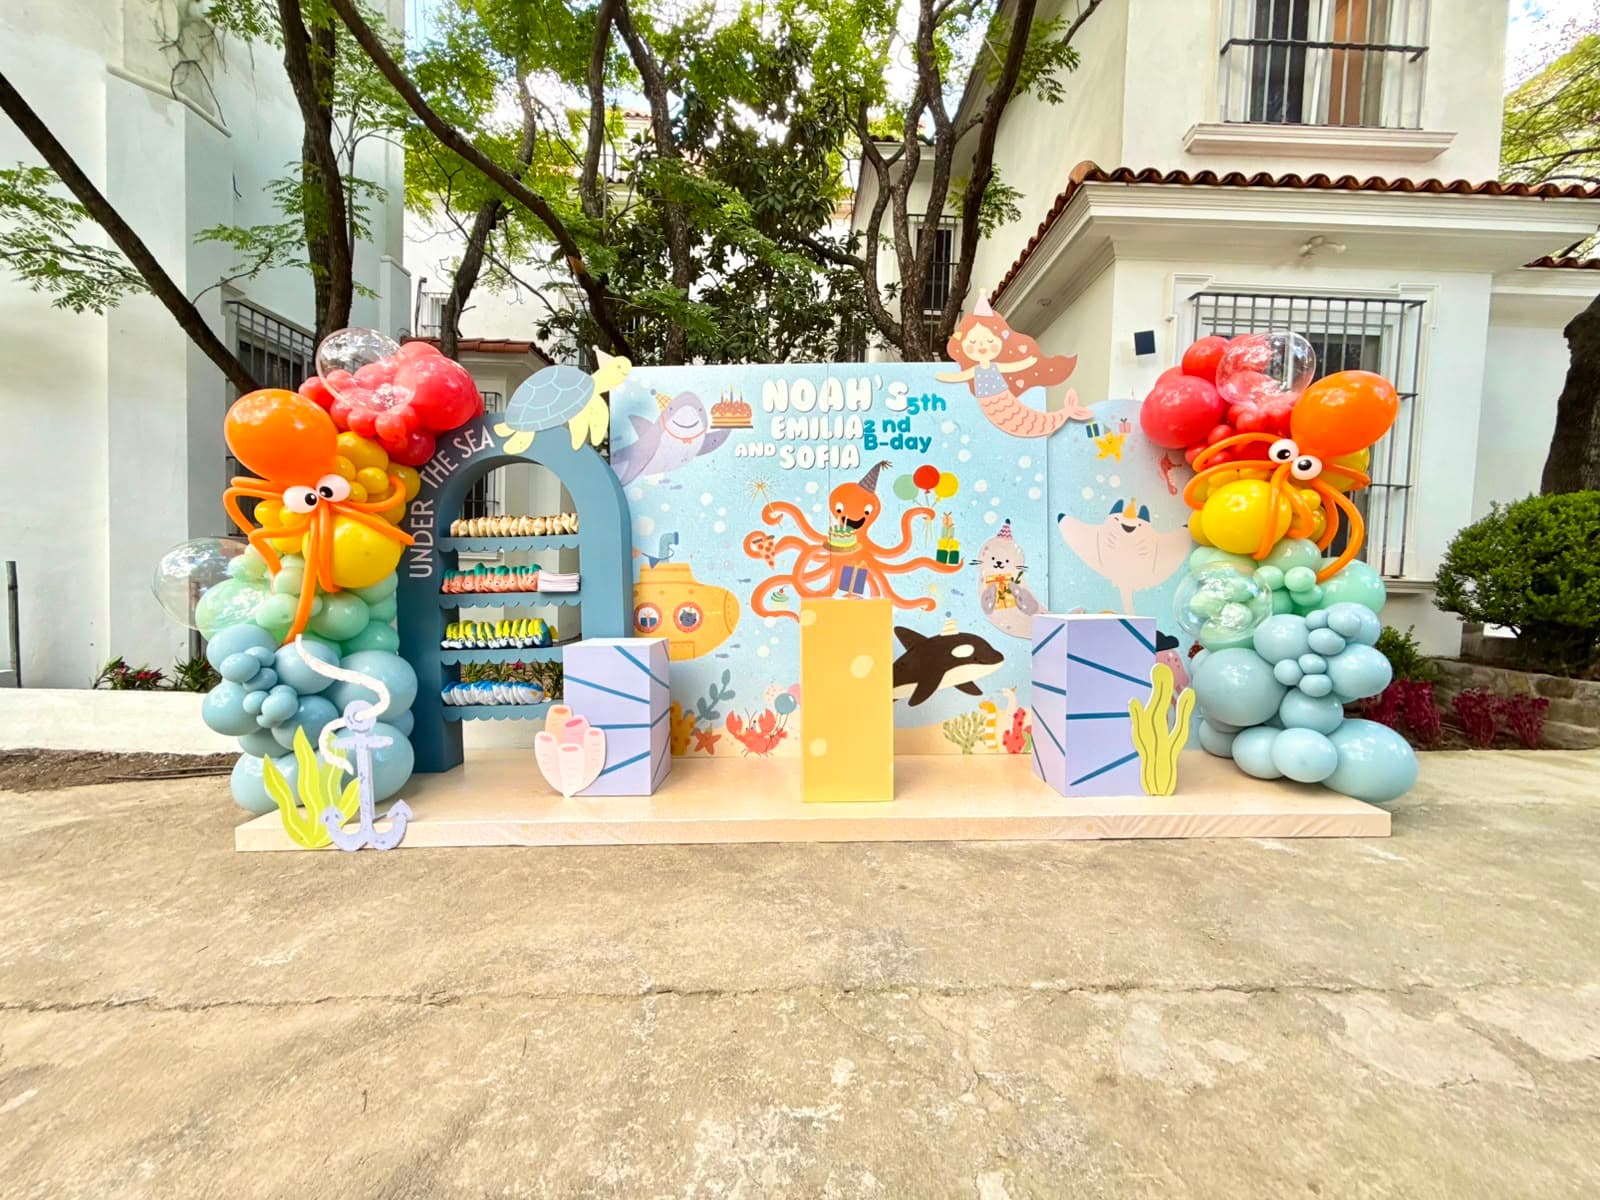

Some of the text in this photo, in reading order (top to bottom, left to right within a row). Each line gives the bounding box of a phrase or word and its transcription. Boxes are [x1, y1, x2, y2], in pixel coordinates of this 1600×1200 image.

[906, 393, 946, 415] 5th
[771, 415, 864, 440] EMILIA
[735, 441, 861, 470] AND SOFIA
[864, 433, 932, 453] B-day
[408, 425, 496, 578] UNDER THE SEA
